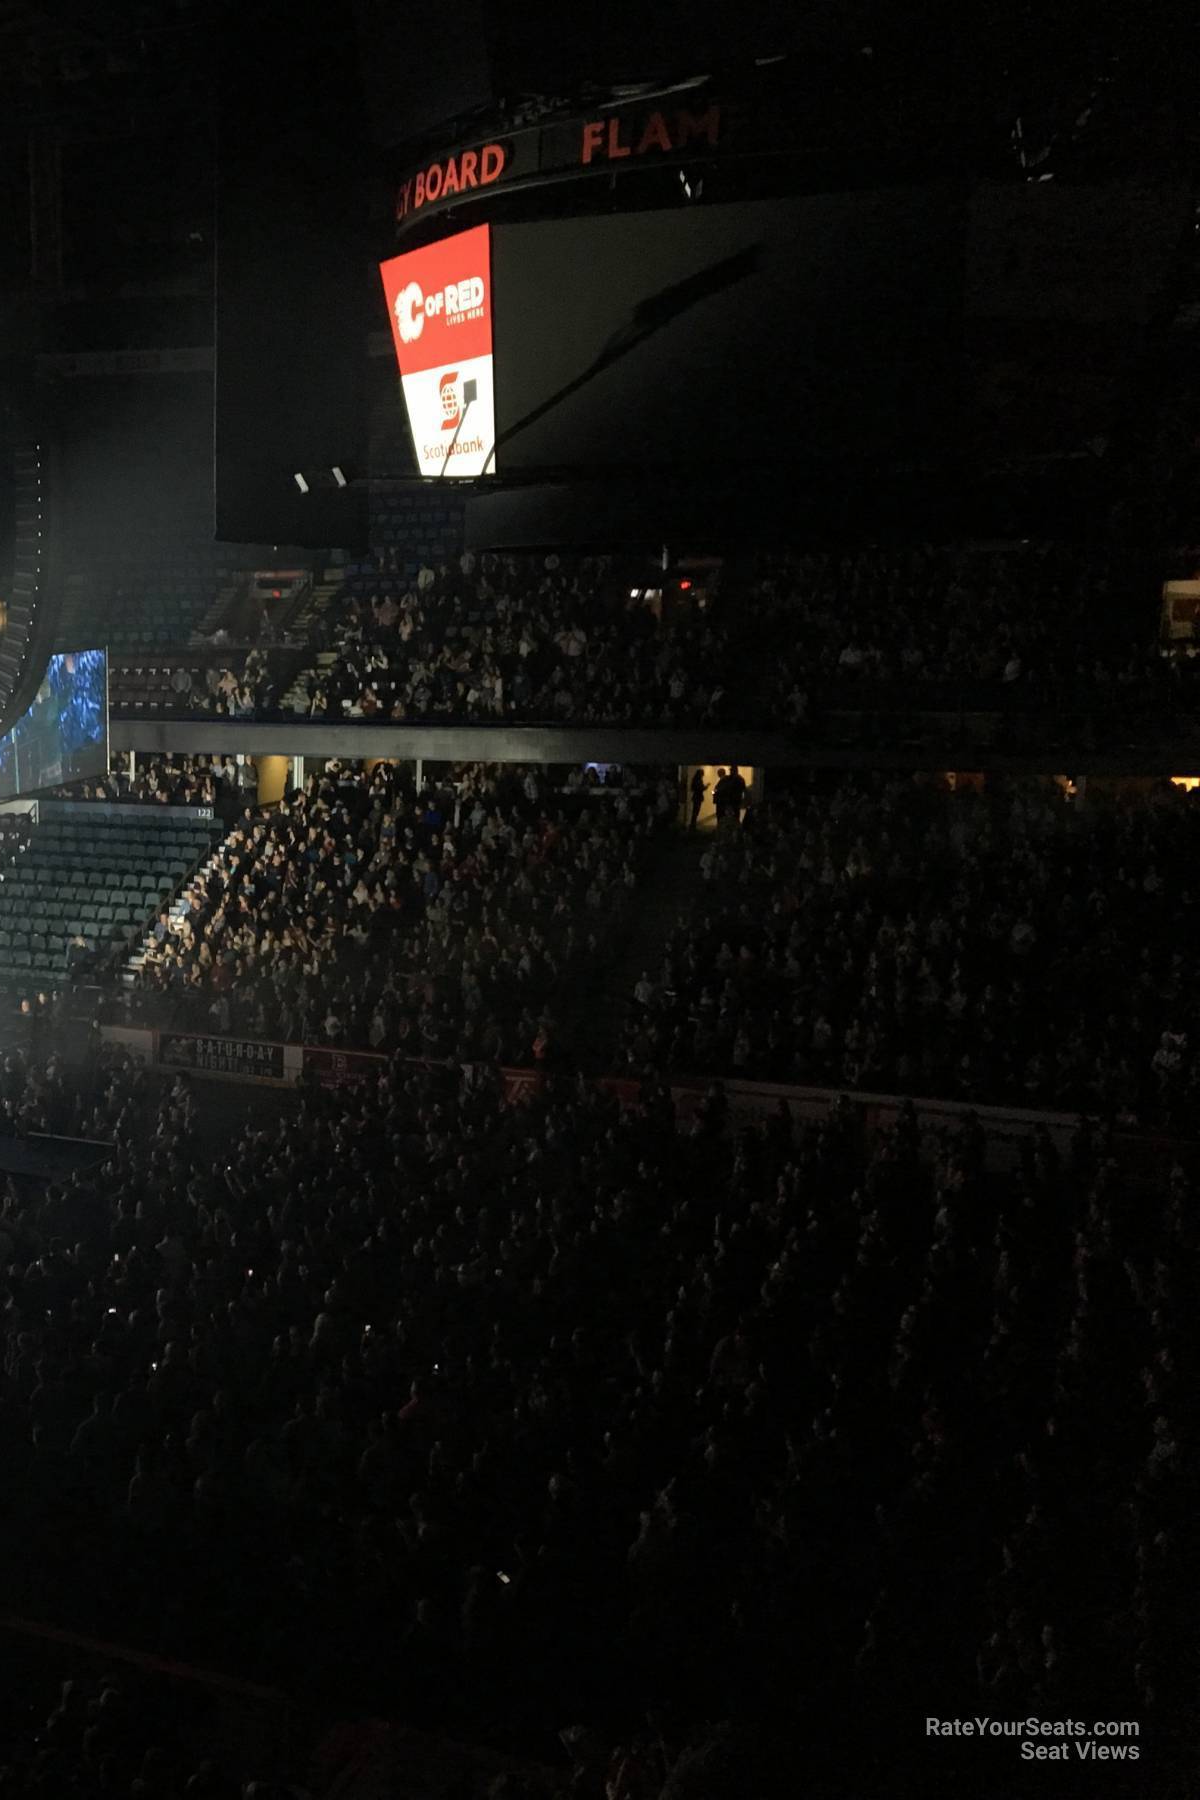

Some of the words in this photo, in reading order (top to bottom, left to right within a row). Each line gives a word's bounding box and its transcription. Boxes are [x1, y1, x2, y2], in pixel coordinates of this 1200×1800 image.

[413, 143, 506, 209] BOARD
[444, 277, 485, 315] RED
[423, 435, 484, 460] Scotiabank
